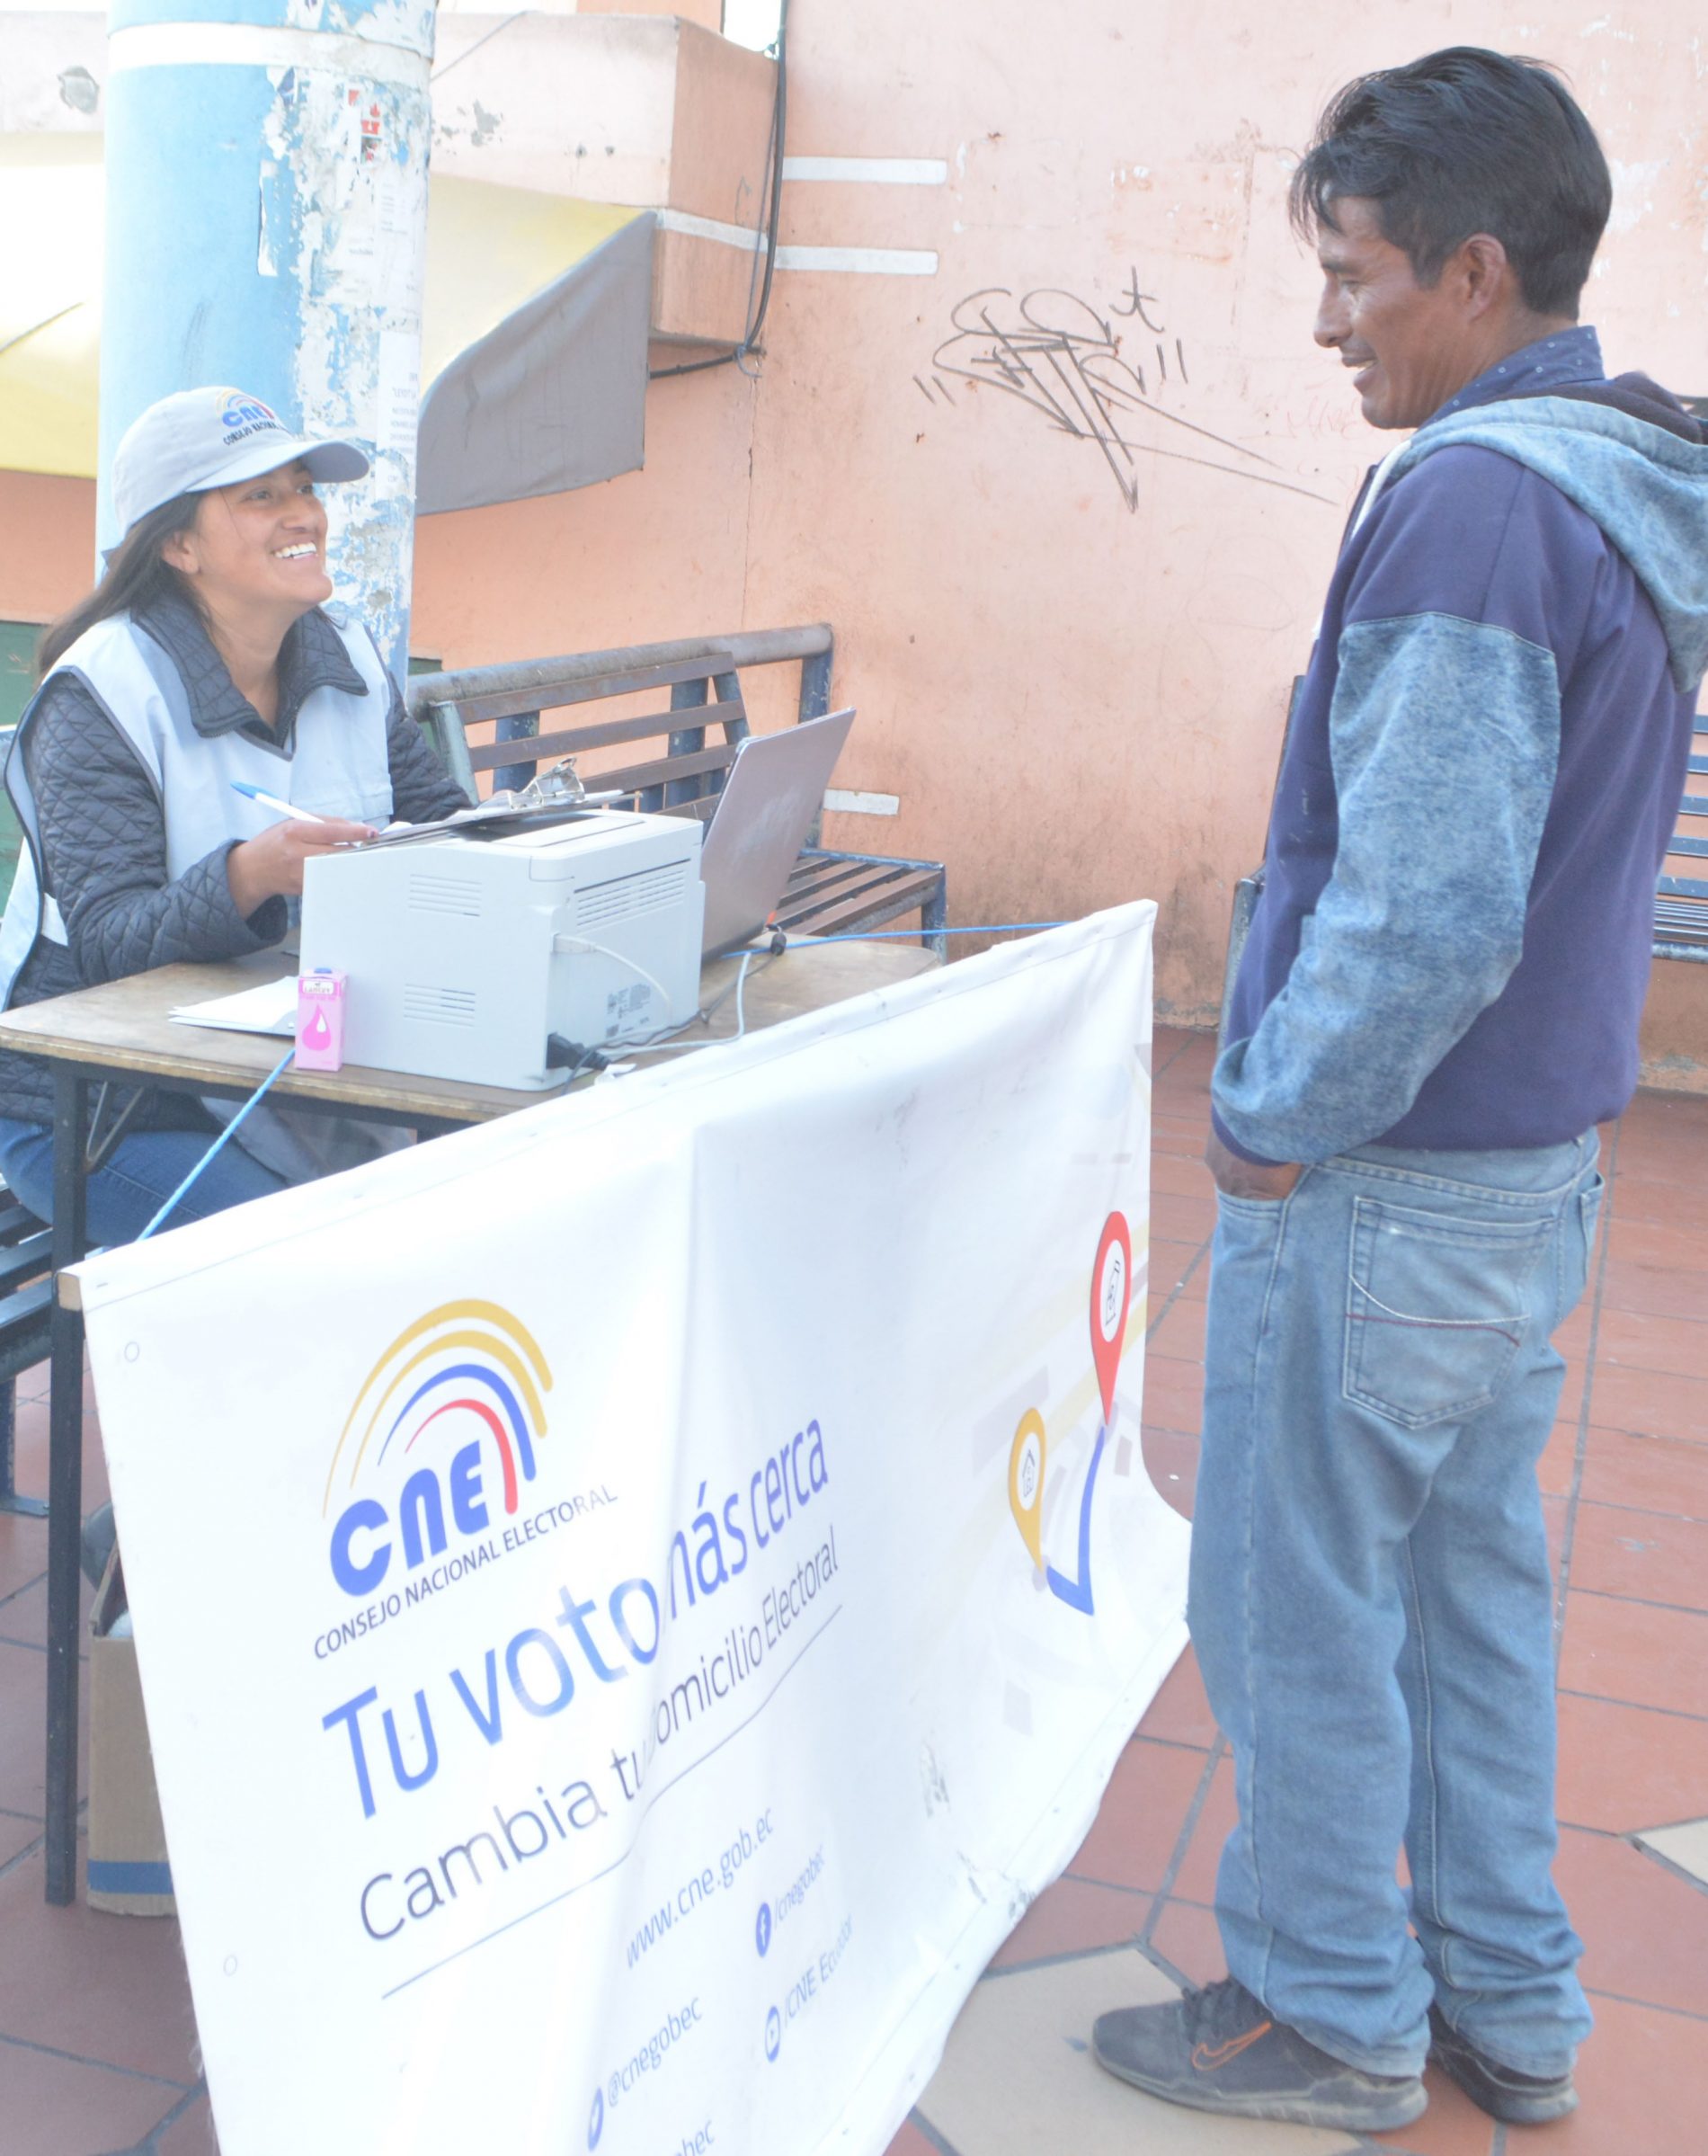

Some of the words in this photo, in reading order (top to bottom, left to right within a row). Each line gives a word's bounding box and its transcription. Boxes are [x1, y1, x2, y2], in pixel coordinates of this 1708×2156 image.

[314, 1593, 402, 1661] CONSEJO
[405, 1539, 502, 1608] NACIONAL
[502, 1483, 619, 1554] ELECTORAL
[330, 1439, 491, 1597] CNE
[449, 1577, 660, 1747] voto
[750, 1418, 829, 1551] cerca
[360, 1779, 609, 1943] Cambia
[648, 1625, 763, 1764] omicilio
[762, 1523, 840, 1652] Electoral
[627, 1808, 775, 1969] www.cne.gob.ec
[608, 1997, 704, 2107] @cnegobec
